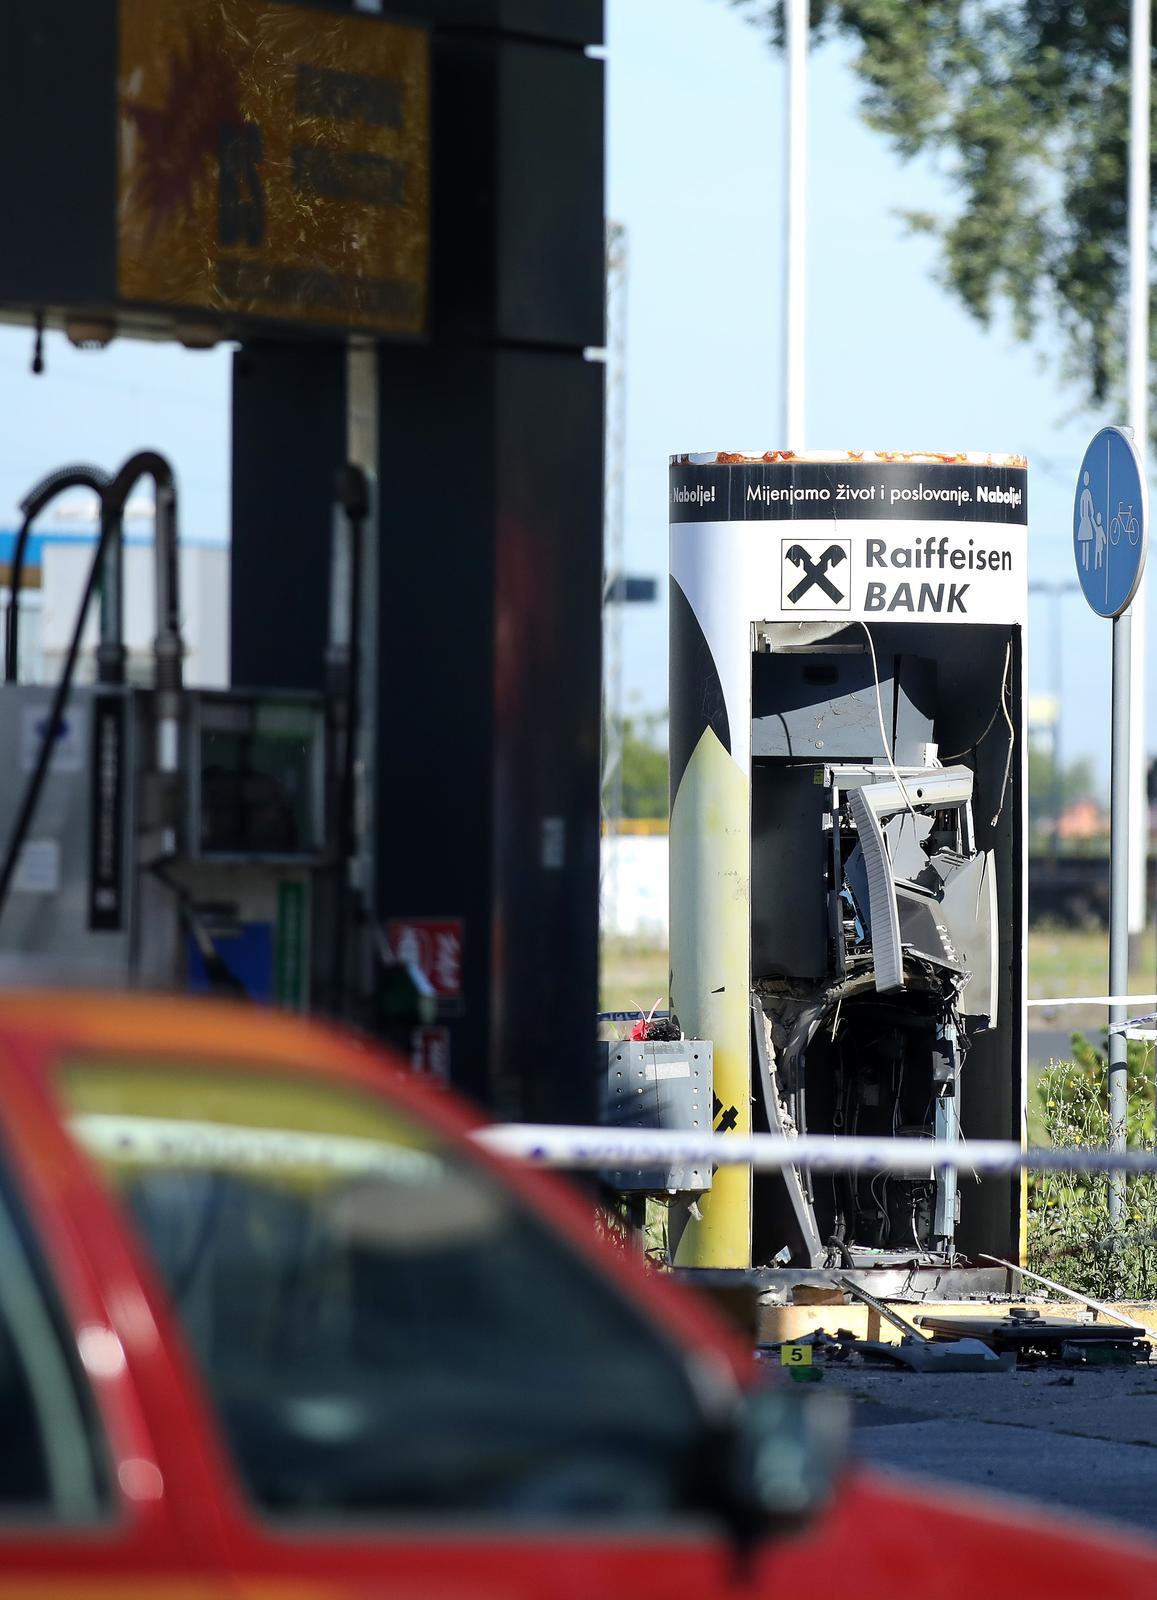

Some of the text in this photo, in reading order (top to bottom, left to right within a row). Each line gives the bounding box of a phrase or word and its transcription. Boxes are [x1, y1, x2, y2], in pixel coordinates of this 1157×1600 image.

[673, 485, 716, 507] Nabolje!
[746, 483, 1022, 509] Mijenjamo život i poslovanje. Nabolje!
[866, 536, 1012, 571] Raiffeisen
[863, 582, 971, 613] BANK
[791, 1348, 803, 1362] 5
